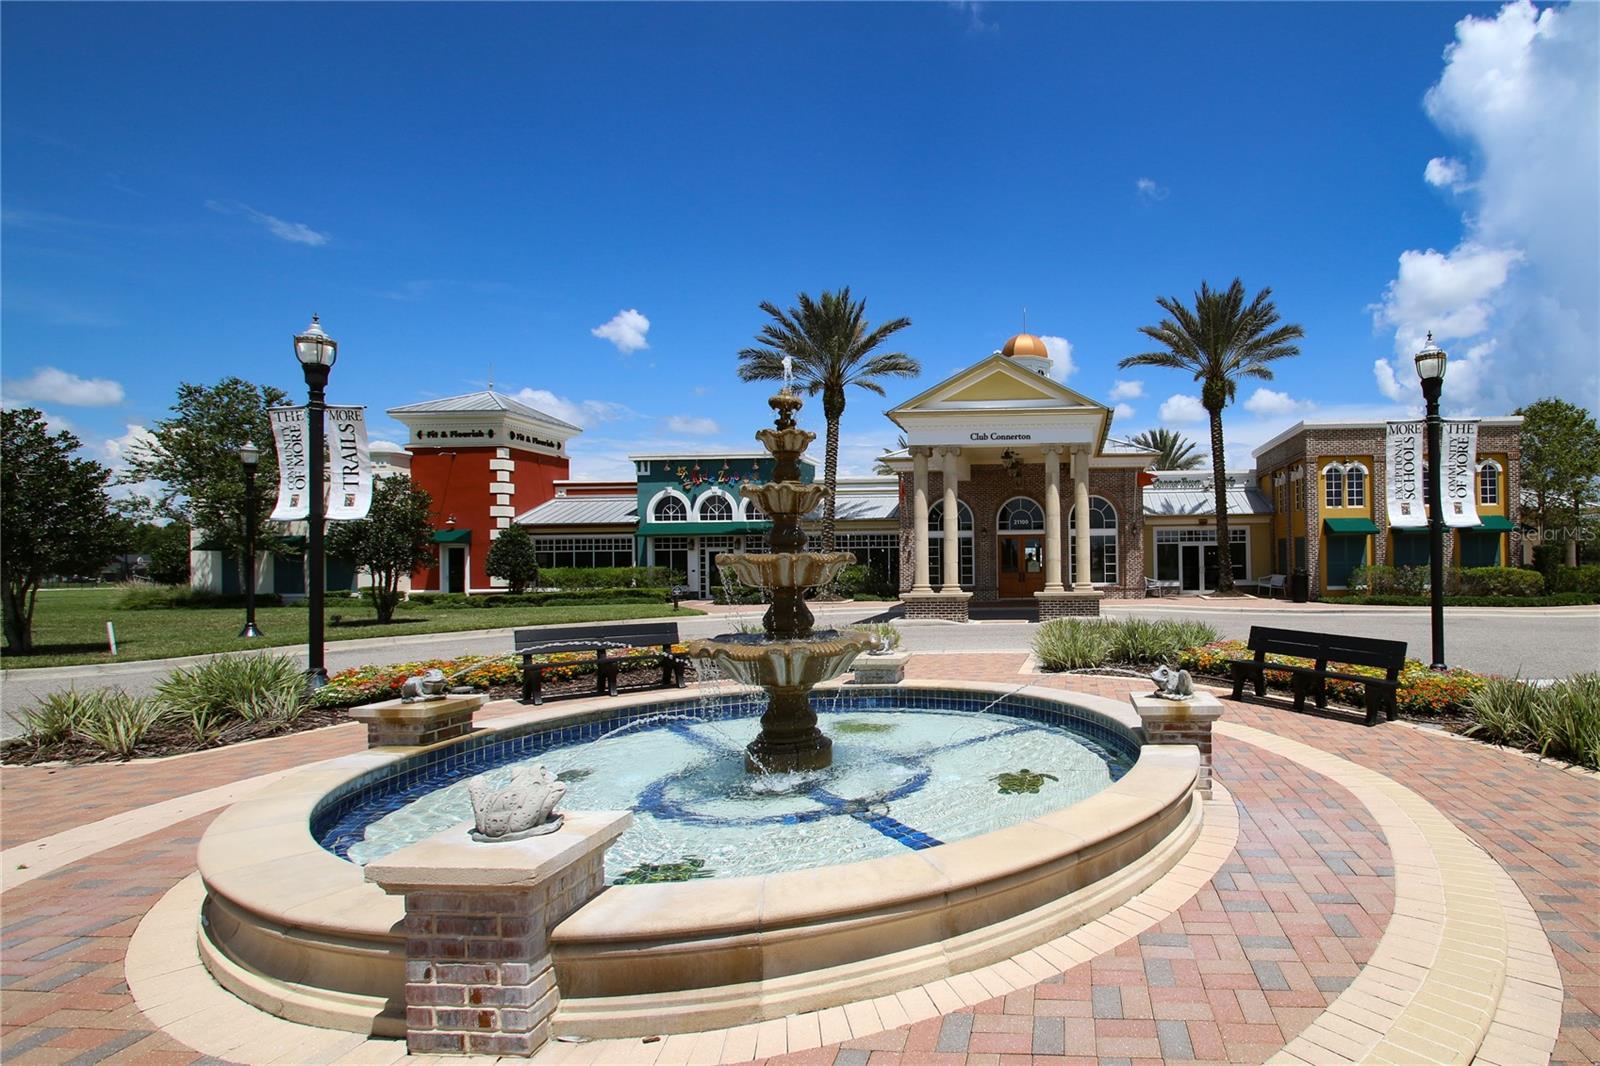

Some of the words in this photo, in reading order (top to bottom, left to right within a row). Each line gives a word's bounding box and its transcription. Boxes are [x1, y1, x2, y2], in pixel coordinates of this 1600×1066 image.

[274, 411, 304, 422] THE
[329, 410, 362, 421] MORE
[1389, 423, 1422, 435] MORE
[1448, 423, 1474, 434] THE
[290, 424, 304, 468] MORE
[970, 432, 989, 441] Club
[990, 432, 1031, 441] Connerton
[281, 424, 294, 491] COMMUNITY
[339, 423, 359, 491] TRAILS
[1395, 437, 1404, 500] EXCEPTIONAL
[1403, 436, 1416, 501] SCHOOLS
[1448, 436, 1457, 498] COMMUNITY
[1456, 436, 1469, 477] MORE
[294, 471, 306, 491] OF
[1456, 480, 1467, 499] OF
